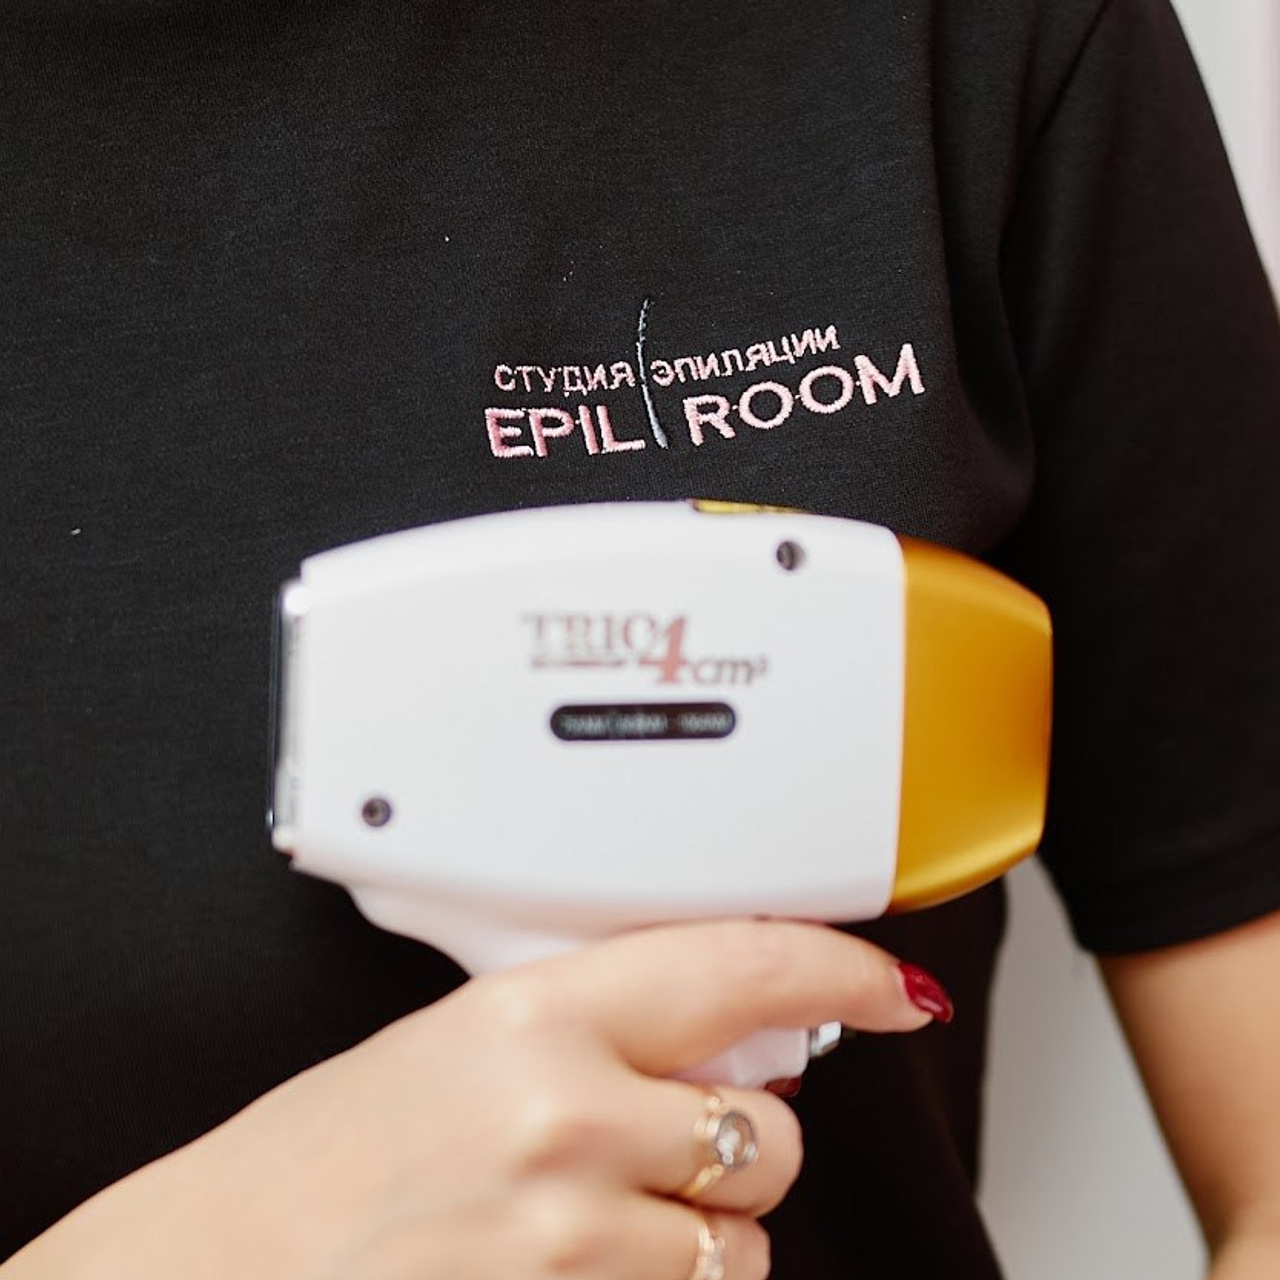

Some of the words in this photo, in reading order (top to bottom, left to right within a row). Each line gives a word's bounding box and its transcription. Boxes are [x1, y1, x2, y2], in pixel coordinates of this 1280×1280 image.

[484, 405, 646, 458] EPIL
[682, 342, 925, 446] ROOM
[493, 360, 635, 398] СТУДИЯ
[649, 324, 840, 387] ЭПИЛЯЦИИ
